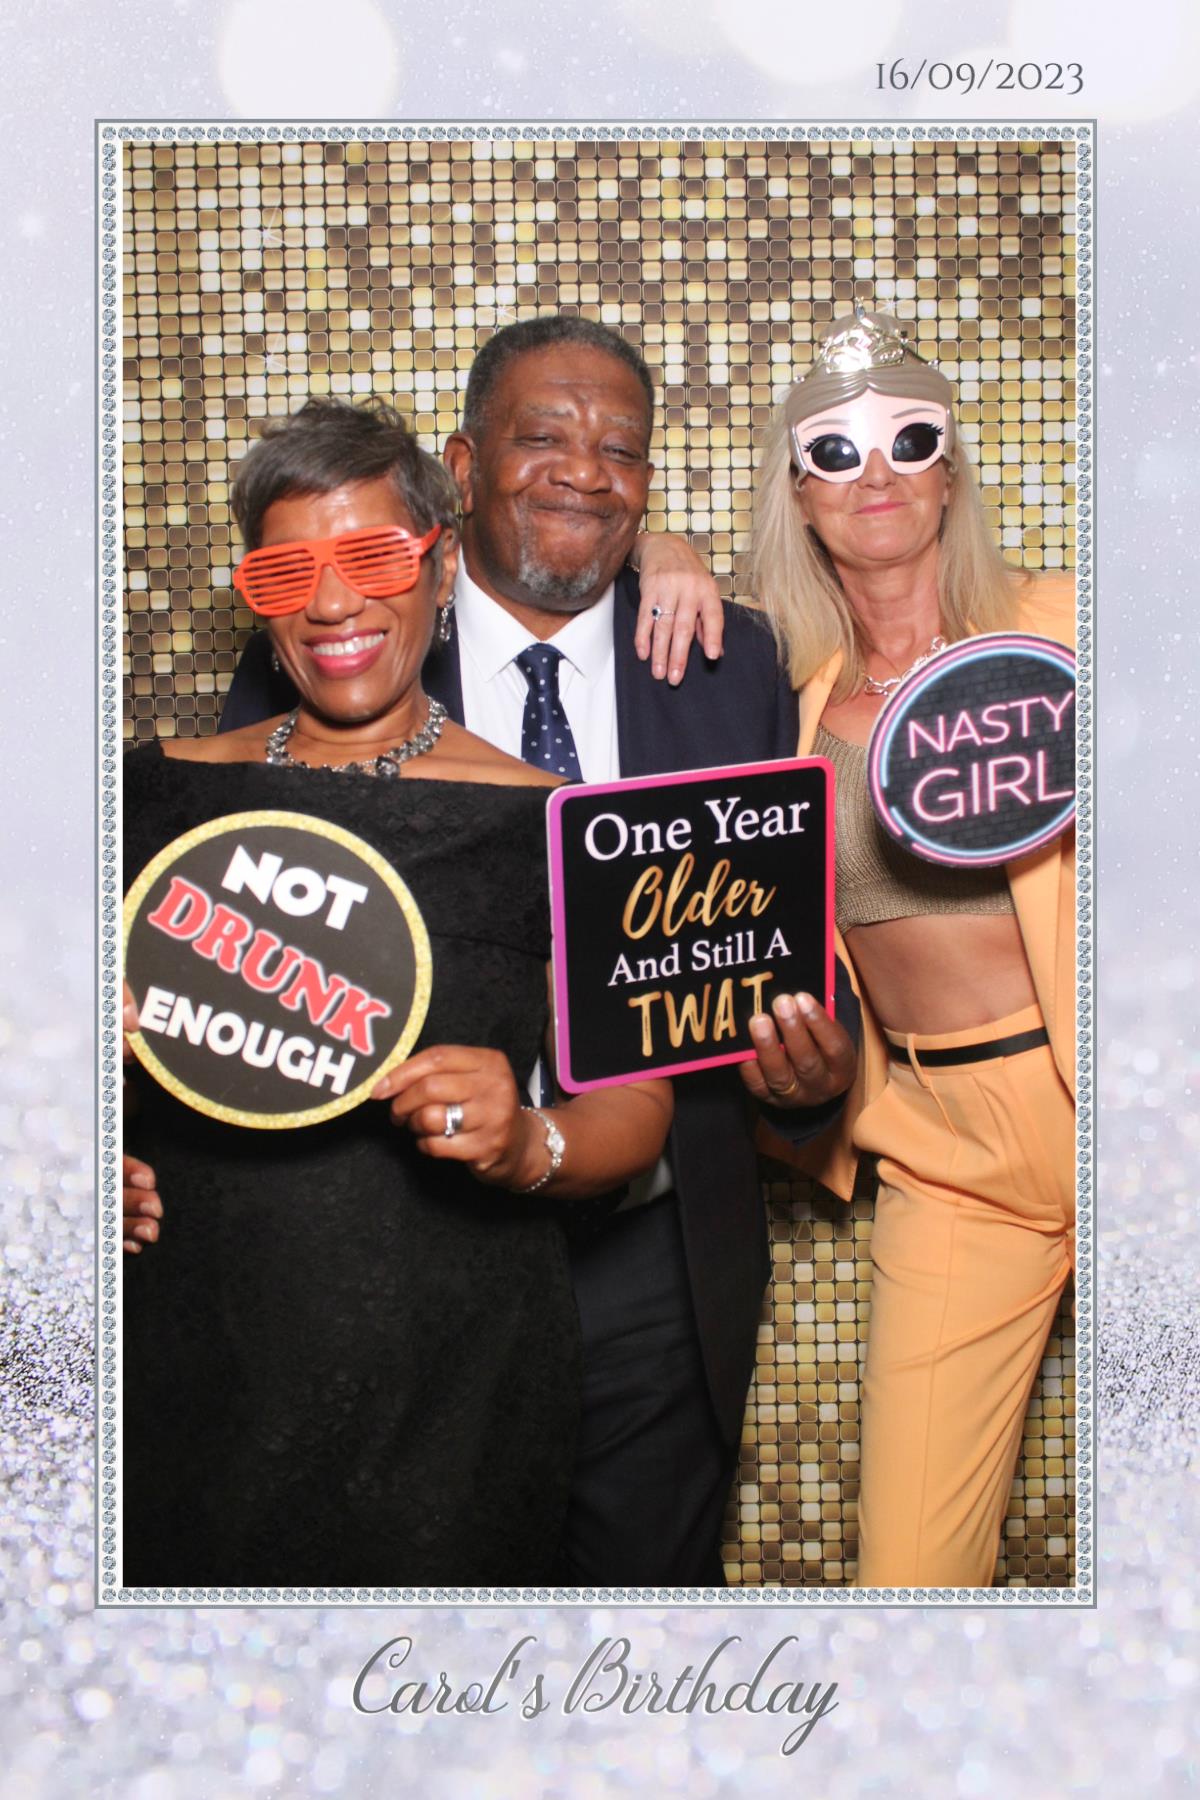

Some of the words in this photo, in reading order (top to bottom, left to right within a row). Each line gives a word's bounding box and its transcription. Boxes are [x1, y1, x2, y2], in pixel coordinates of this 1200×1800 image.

[908, 691, 1074, 760] NASTY
[584, 813, 692, 861] One
[704, 797, 810, 844] Year
[913, 750, 1074, 823] GIRL
[221, 844, 368, 931] NOT
[622, 852, 776, 940] Older
[147, 875, 391, 1056] DRUNK
[607, 943, 681, 986] And
[691, 931, 754, 972] Still
[765, 928, 791, 958] A
[138, 986, 356, 1095] ENOUGH
[628, 971, 774, 1057] TWAT
